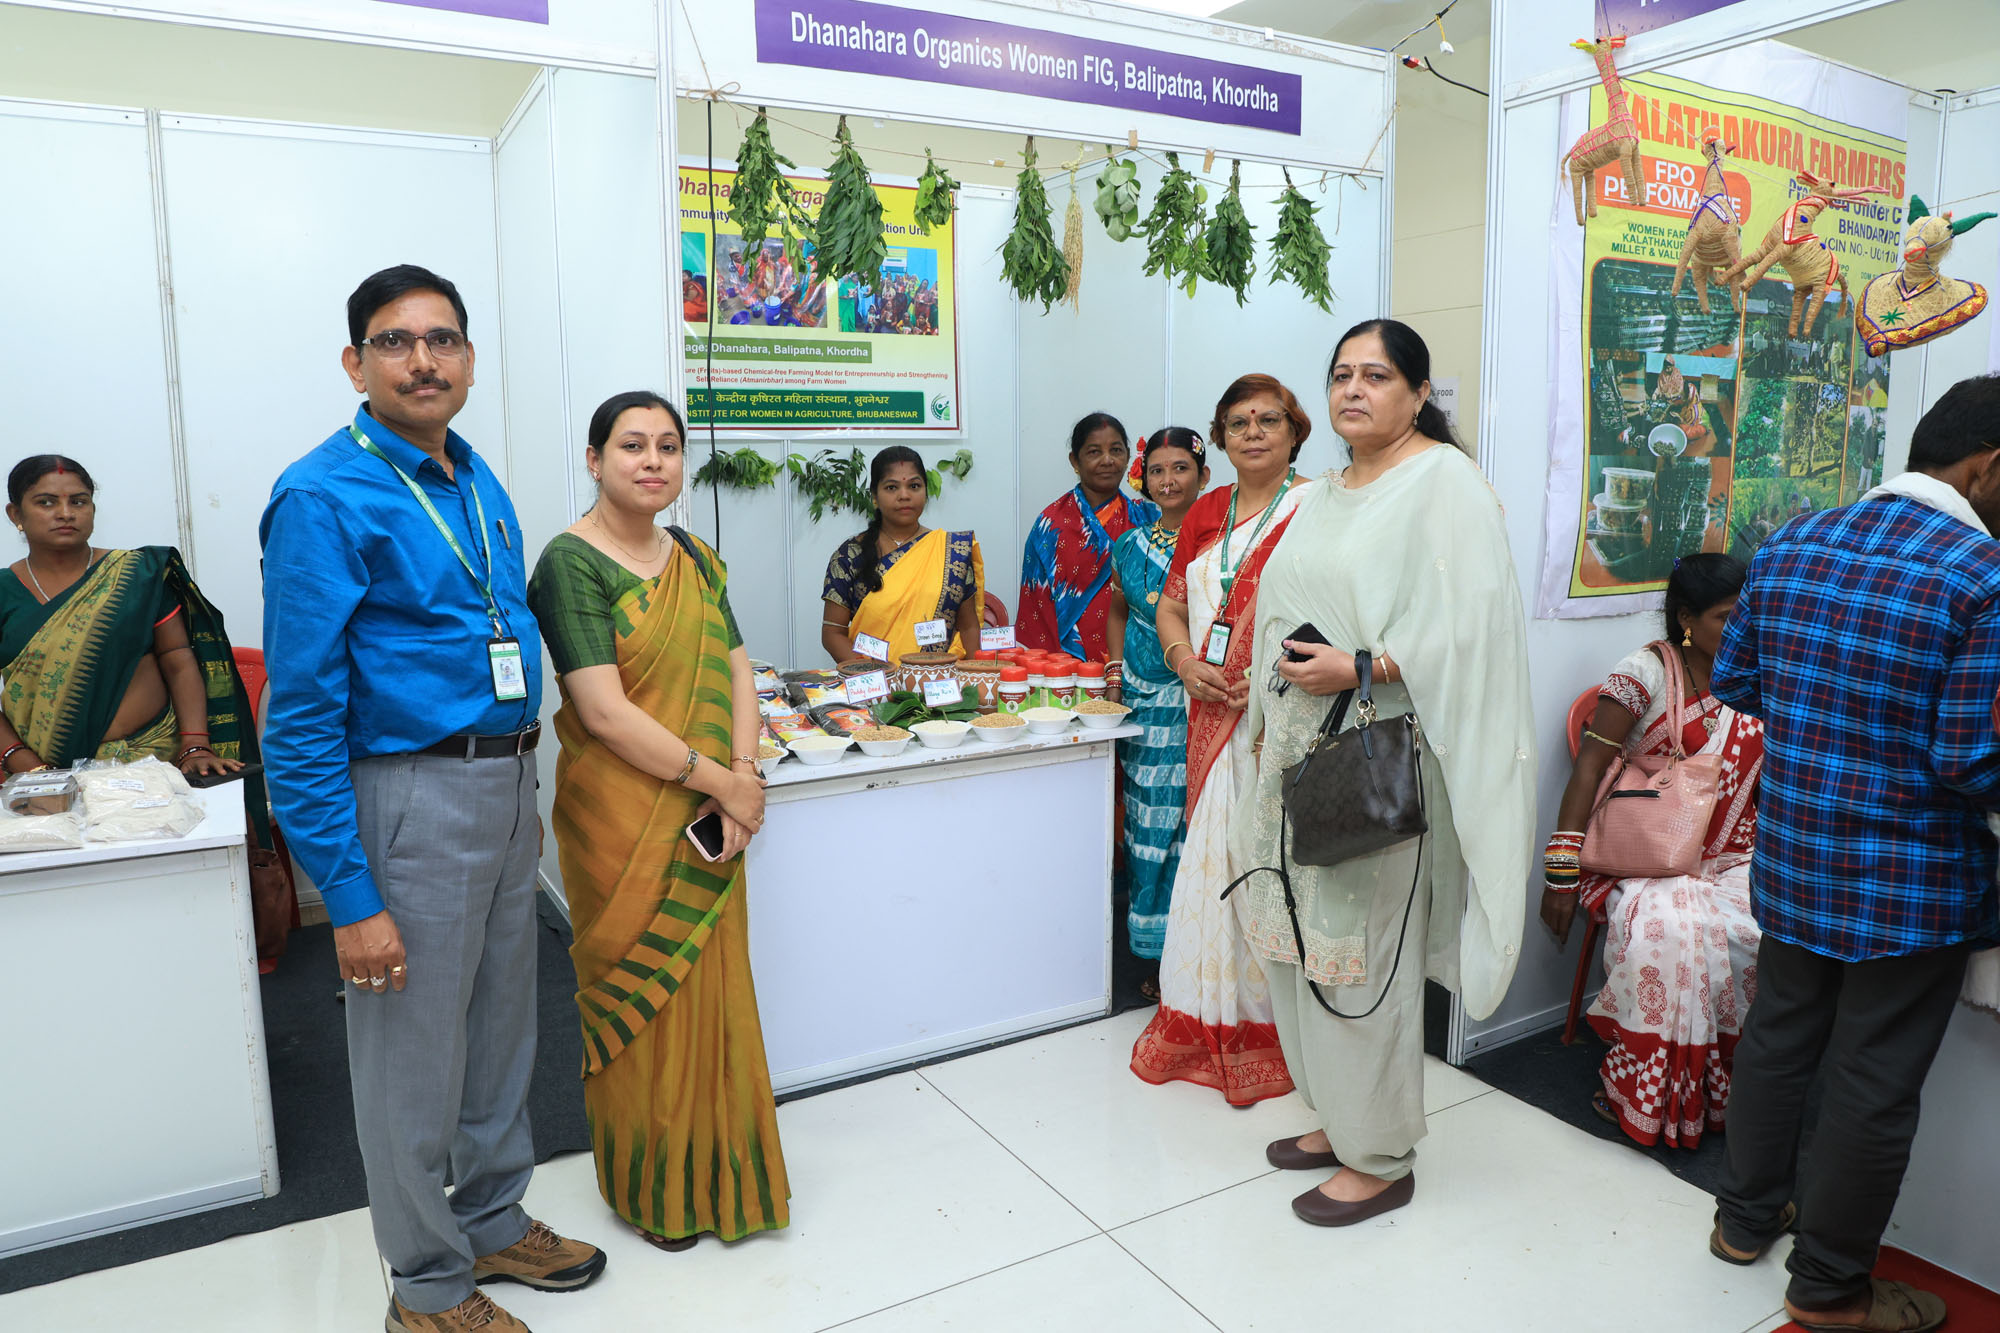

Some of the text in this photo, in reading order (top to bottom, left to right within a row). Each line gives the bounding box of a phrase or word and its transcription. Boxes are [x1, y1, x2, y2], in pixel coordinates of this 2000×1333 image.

[791, 11, 1278, 112] Dhanahara Organics Women FIG, Balipatna, Khordha
[1655, 160, 1696, 187] FPO
[1810, 137, 1906, 199] FARMERS
[1628, 223, 1664, 236] WOMEN
[1622, 233, 1685, 249] KALATHAKUR
[1611, 242, 1647, 255] MILLET
[1649, 248, 1656, 257] &
[685, 343, 869, 357] age: Dhanahara, Balipatna, Khordha
[788, 369, 814, 377] Farming
[845, 371, 896, 379] Entrepreneurship
[909, 371, 949, 380] Strengthening
[716, 391, 747, 402] केन्द्रीय
[750, 391, 782, 405] कृषिरत
[784, 392, 813, 404] महिला
[854, 393, 890, 406] भुवनेश्वर
[730, 410, 748, 418] FOR
[750, 410, 783, 418] WOMEN
[784, 410, 793, 418] IN
[795, 410, 855, 419] AGRICULTURE,
